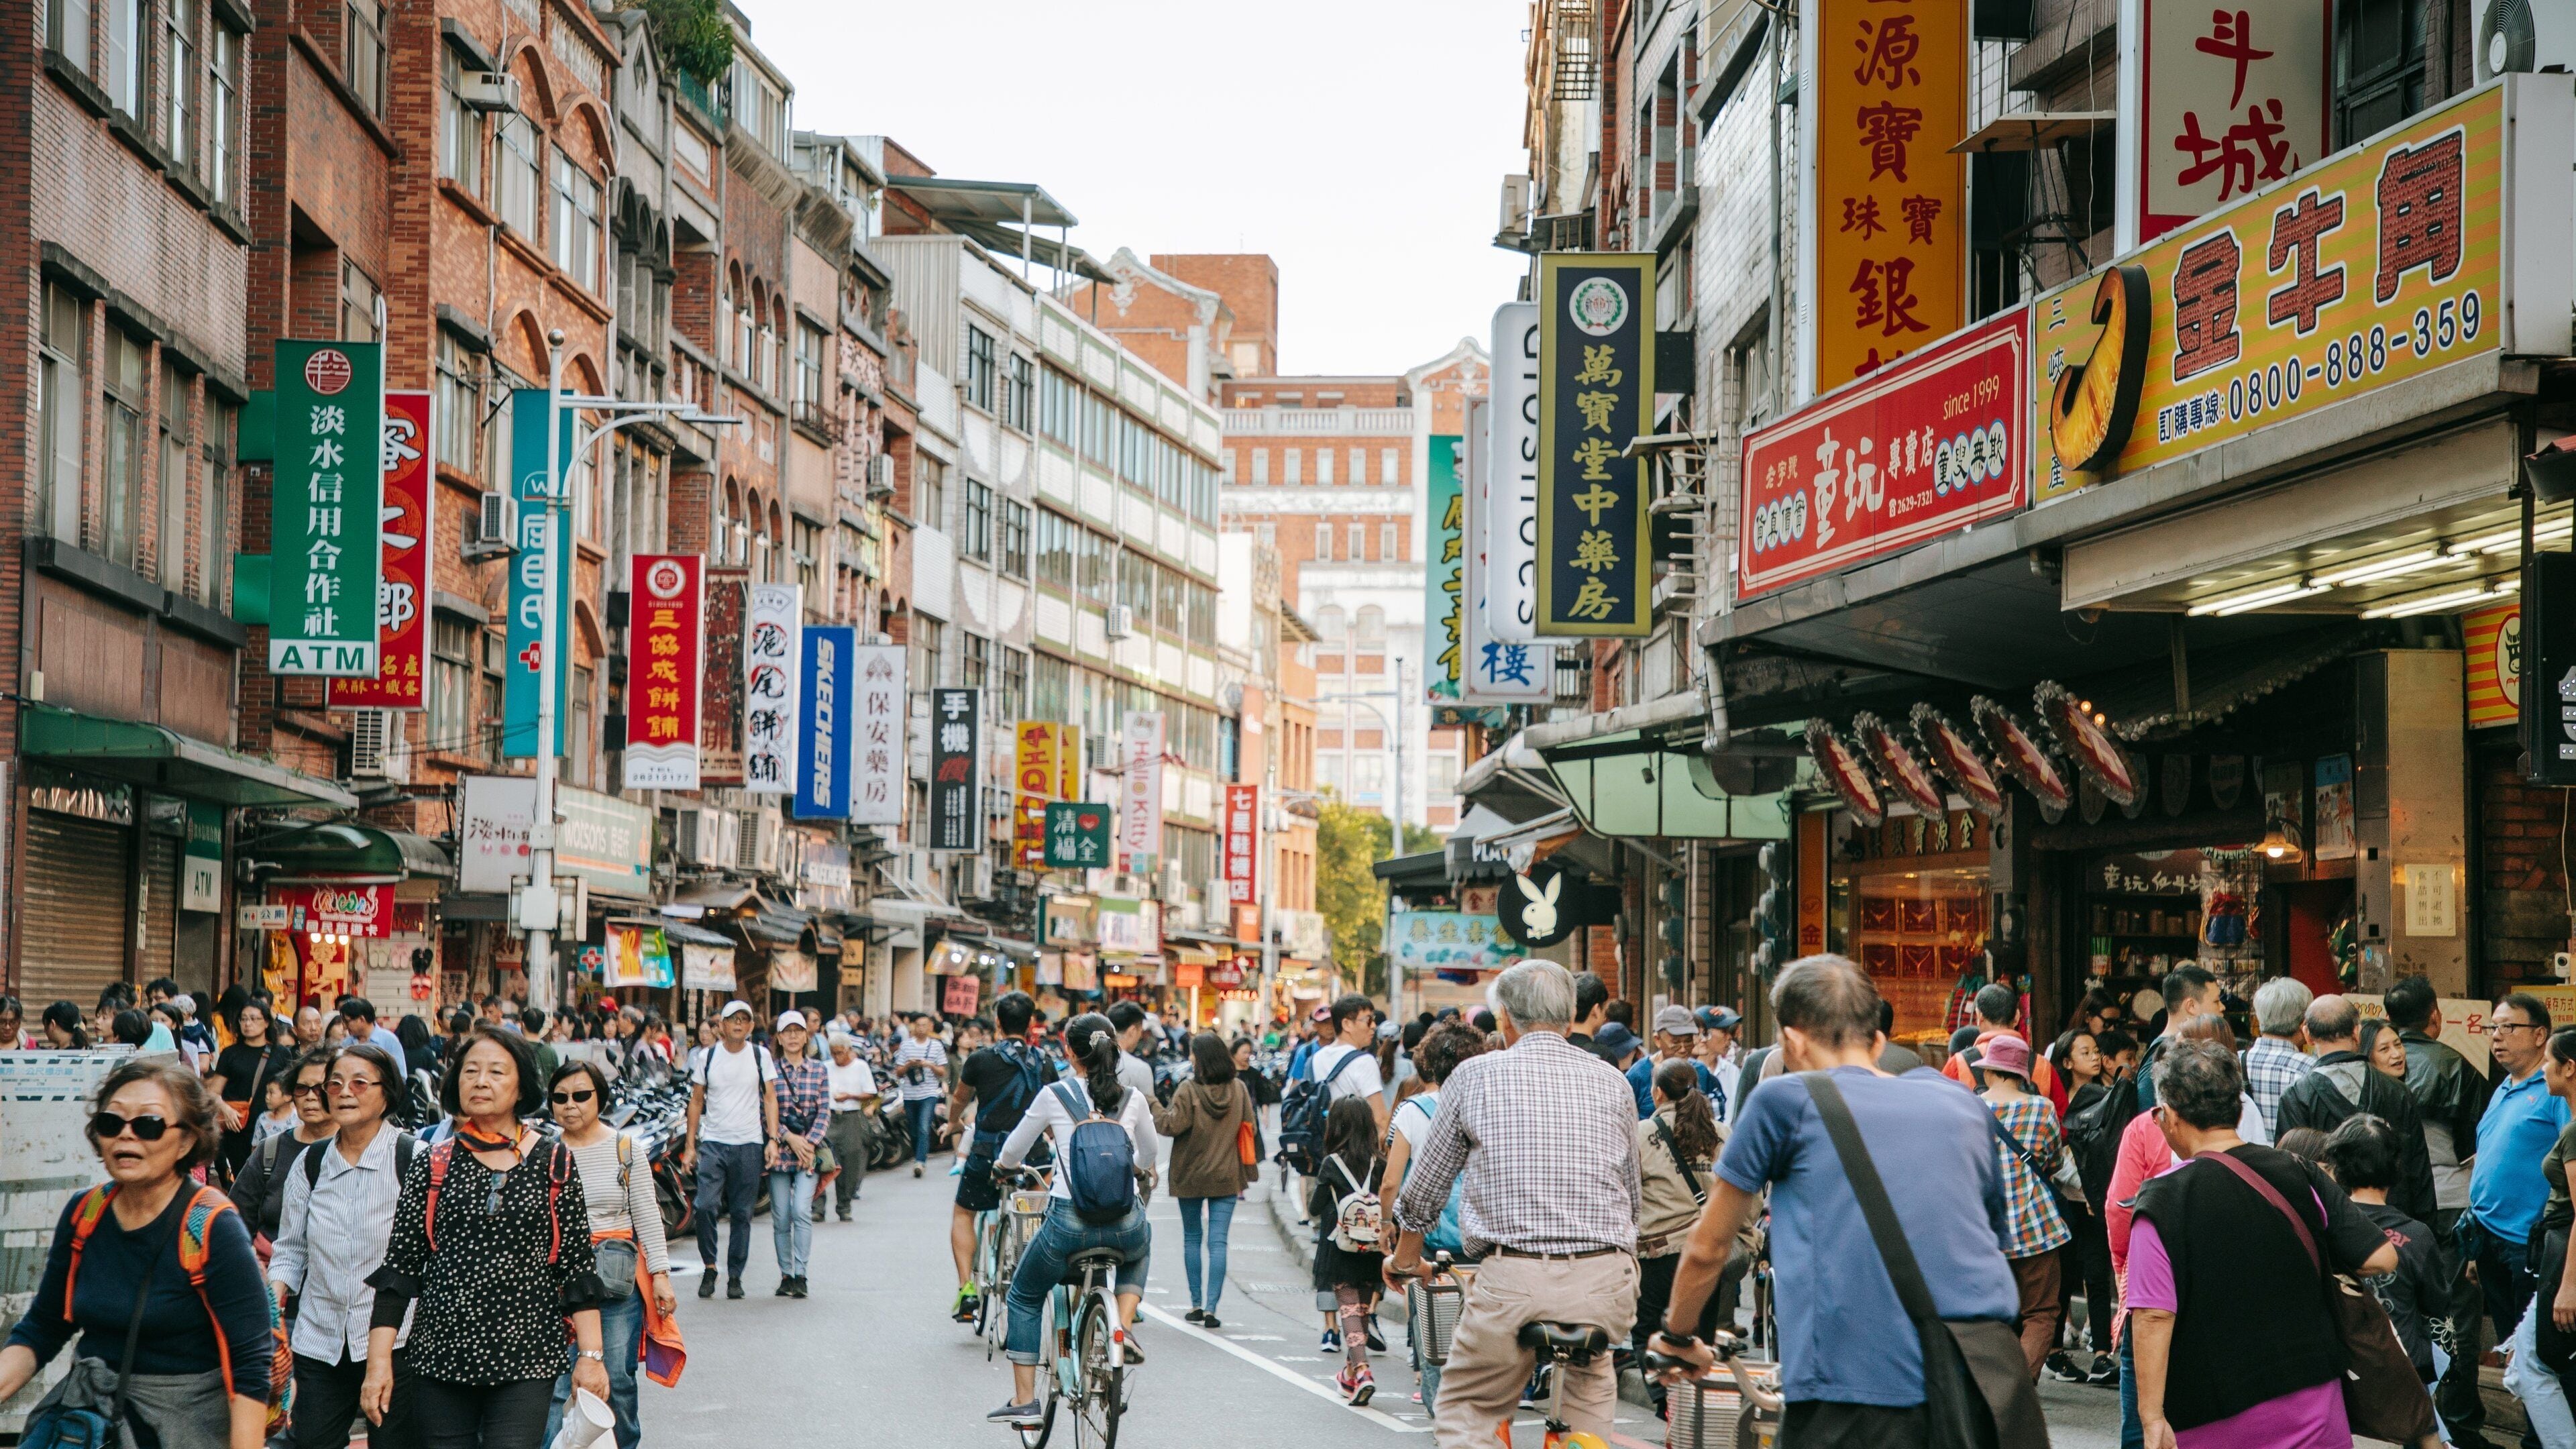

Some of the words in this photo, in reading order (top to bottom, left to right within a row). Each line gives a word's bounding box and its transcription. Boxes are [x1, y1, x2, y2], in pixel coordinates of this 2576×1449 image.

[1854, 0, 1923, 182] 源寶
[2174, 9, 2301, 202] 斗城
[1840, 195, 1942, 246] 珠寶
[2173, 127, 2464, 384] 金牛角
[1943, 393, 1970, 421] since
[1972, 374, 2000, 408] 1999
[2048, 298, 2066, 490] 三峽產
[2229, 292, 2480, 422] 0800-888-359
[1568, 344, 1623, 620] 萬寶堂中藥房
[1814, 426, 1884, 549] 童玩
[1888, 425, 1934, 480] 專賣店
[1897, 492, 1933, 515] 2629-7321
[303, 404, 345, 637] 淡水信用合作社
[278, 645, 365, 670] ATM
[813, 636, 836, 809] SKECHERS
[941, 692, 970, 753] 手機
[194, 870, 212, 898] ATM
